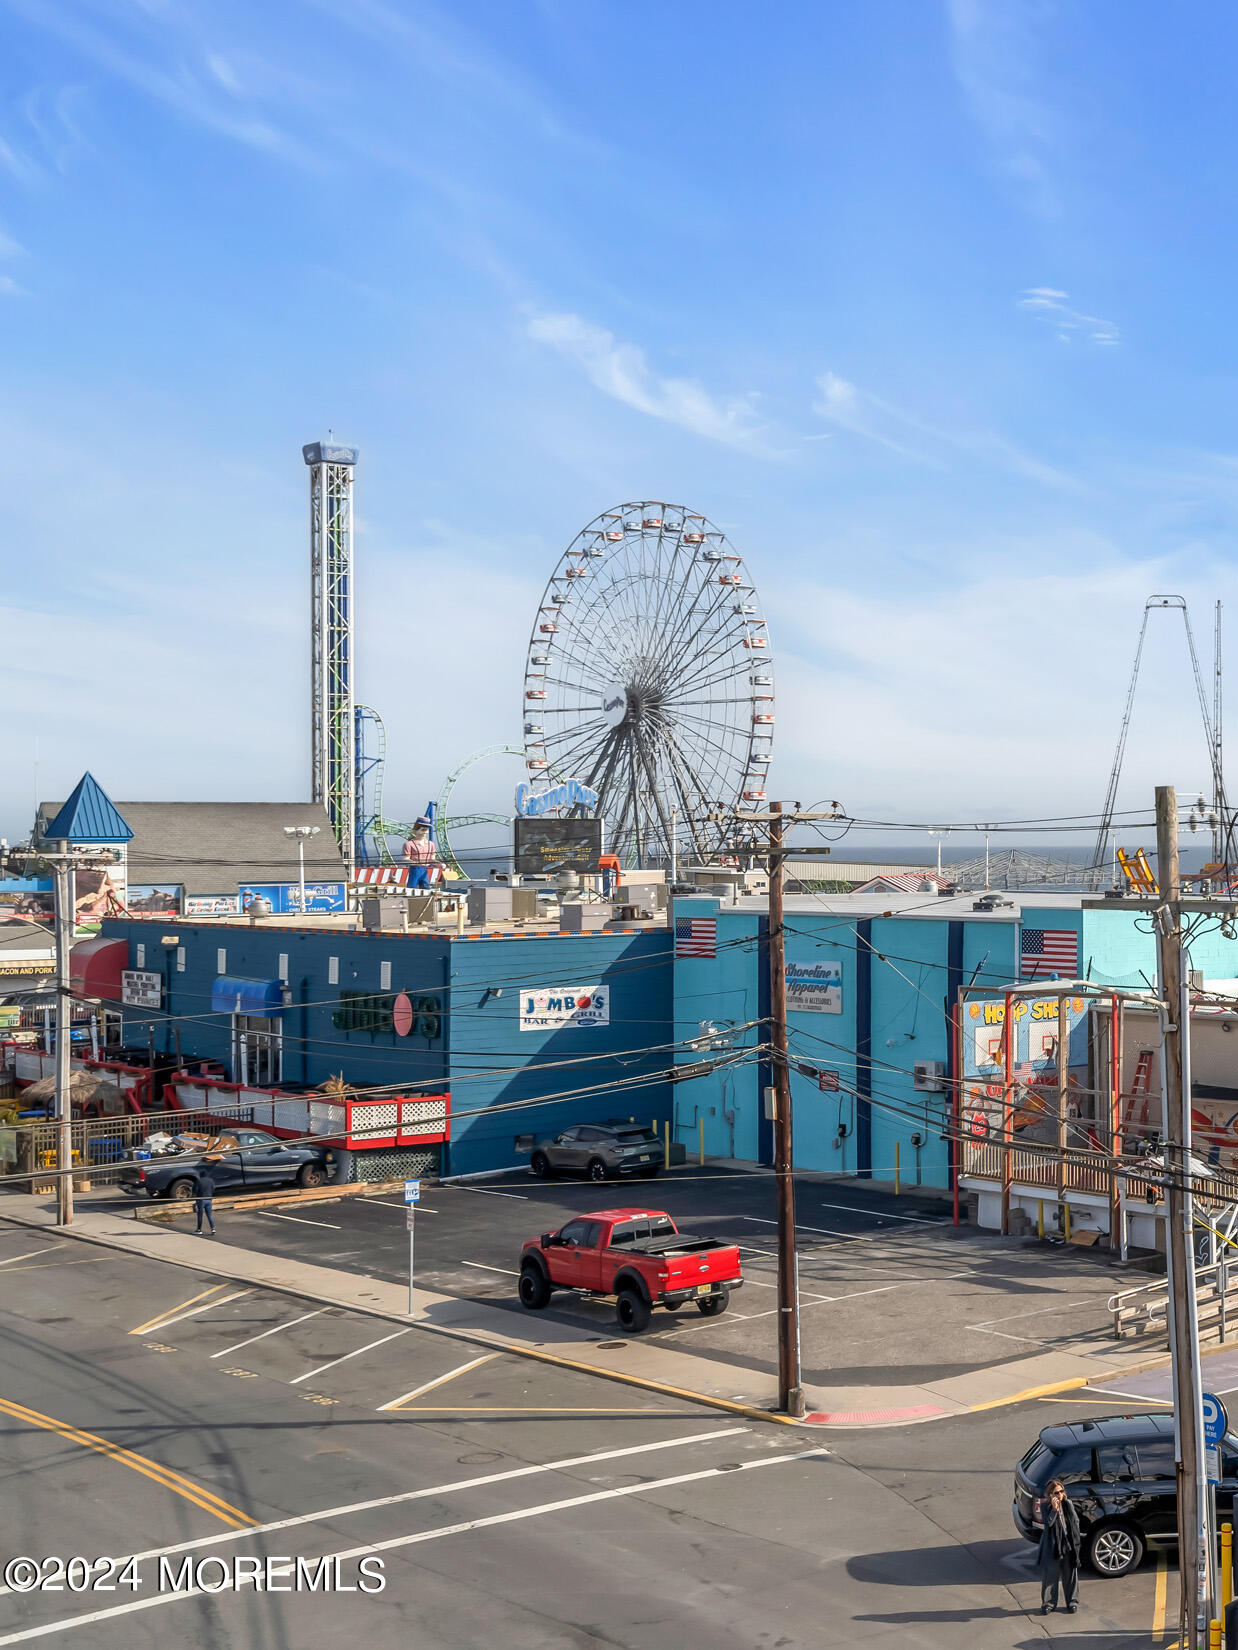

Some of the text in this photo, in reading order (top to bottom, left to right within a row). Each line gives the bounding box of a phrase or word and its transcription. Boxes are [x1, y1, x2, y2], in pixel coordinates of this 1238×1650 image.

[515, 778, 599, 816] Casino Pier
[20, 967, 34, 975] AND
[785, 963, 832, 979] Shoreline
[787, 978, 830, 996] Apparel
[523, 1017, 548, 1025] BAR
[218, 1367, 259, 1379] 1297
